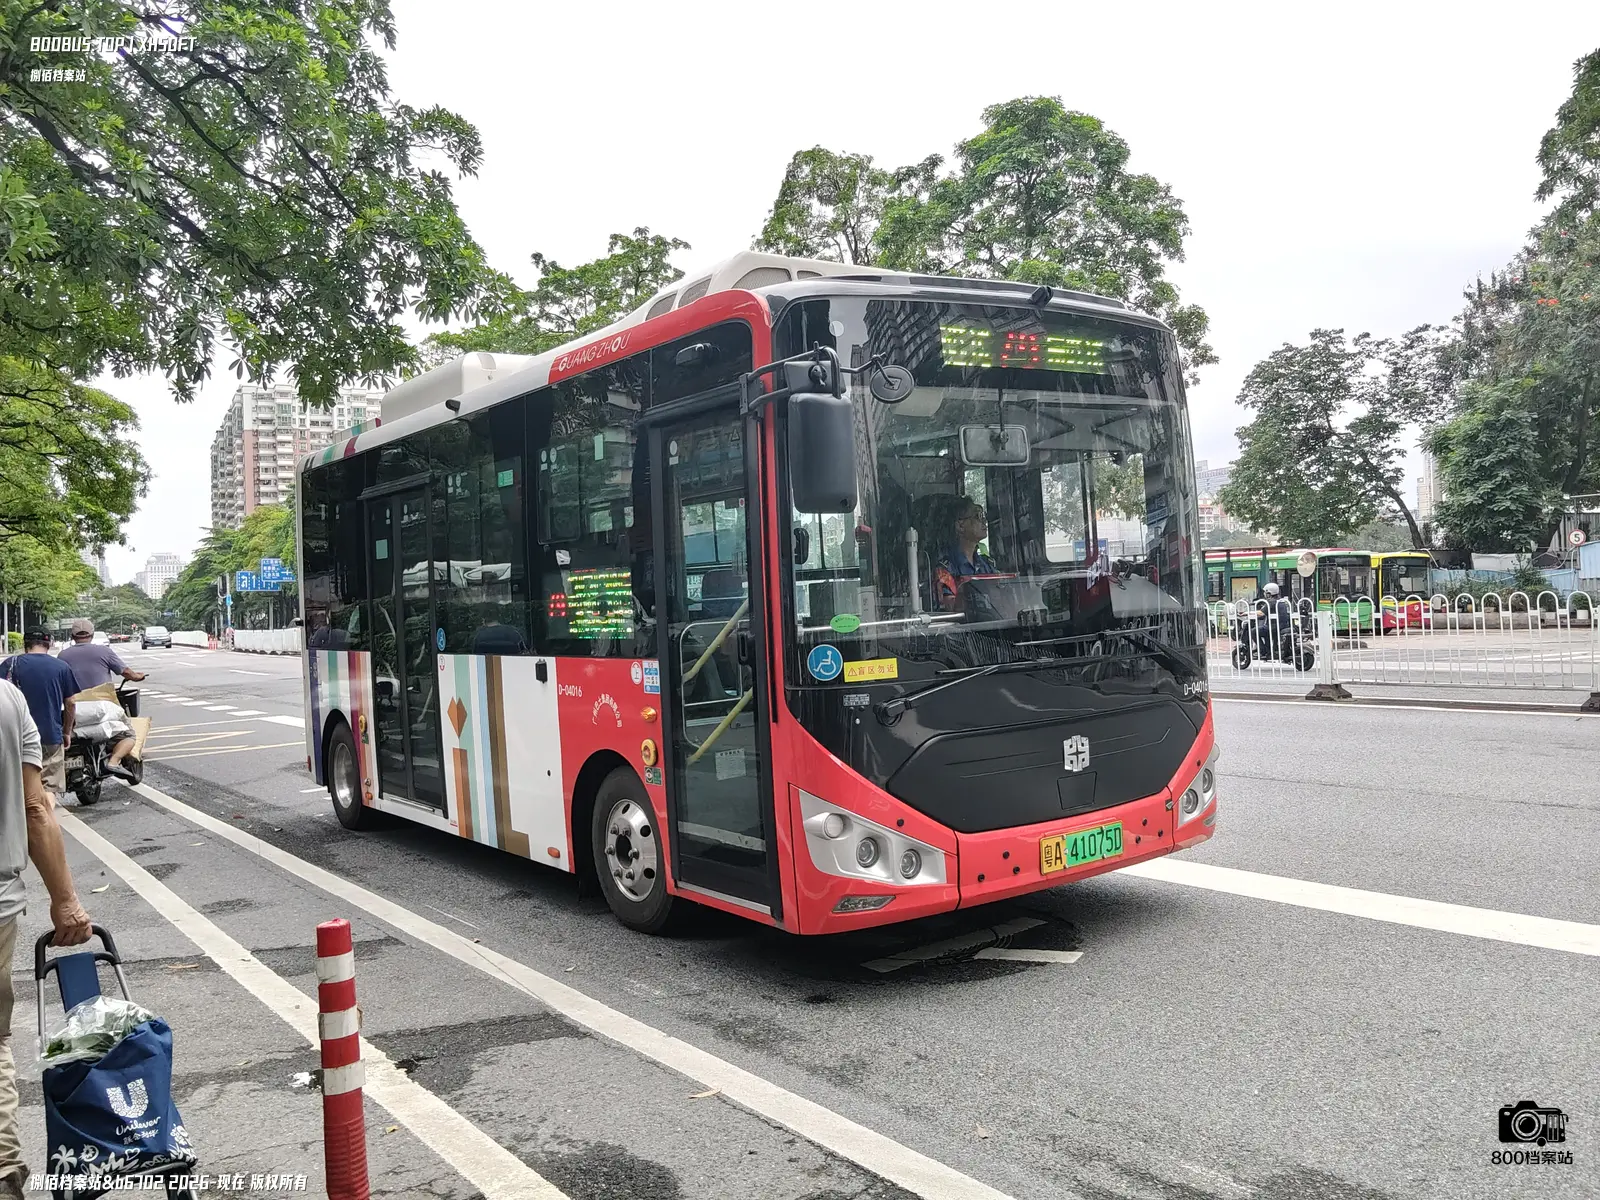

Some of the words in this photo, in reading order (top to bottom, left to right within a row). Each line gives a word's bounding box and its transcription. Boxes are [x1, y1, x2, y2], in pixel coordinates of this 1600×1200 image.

[558, 331, 632, 372] GUANGZHOU
[858, 663, 895, 677] 盲区勿近
[558, 683, 583, 698] D-04016
[115, 1116, 161, 1136] Unilever
